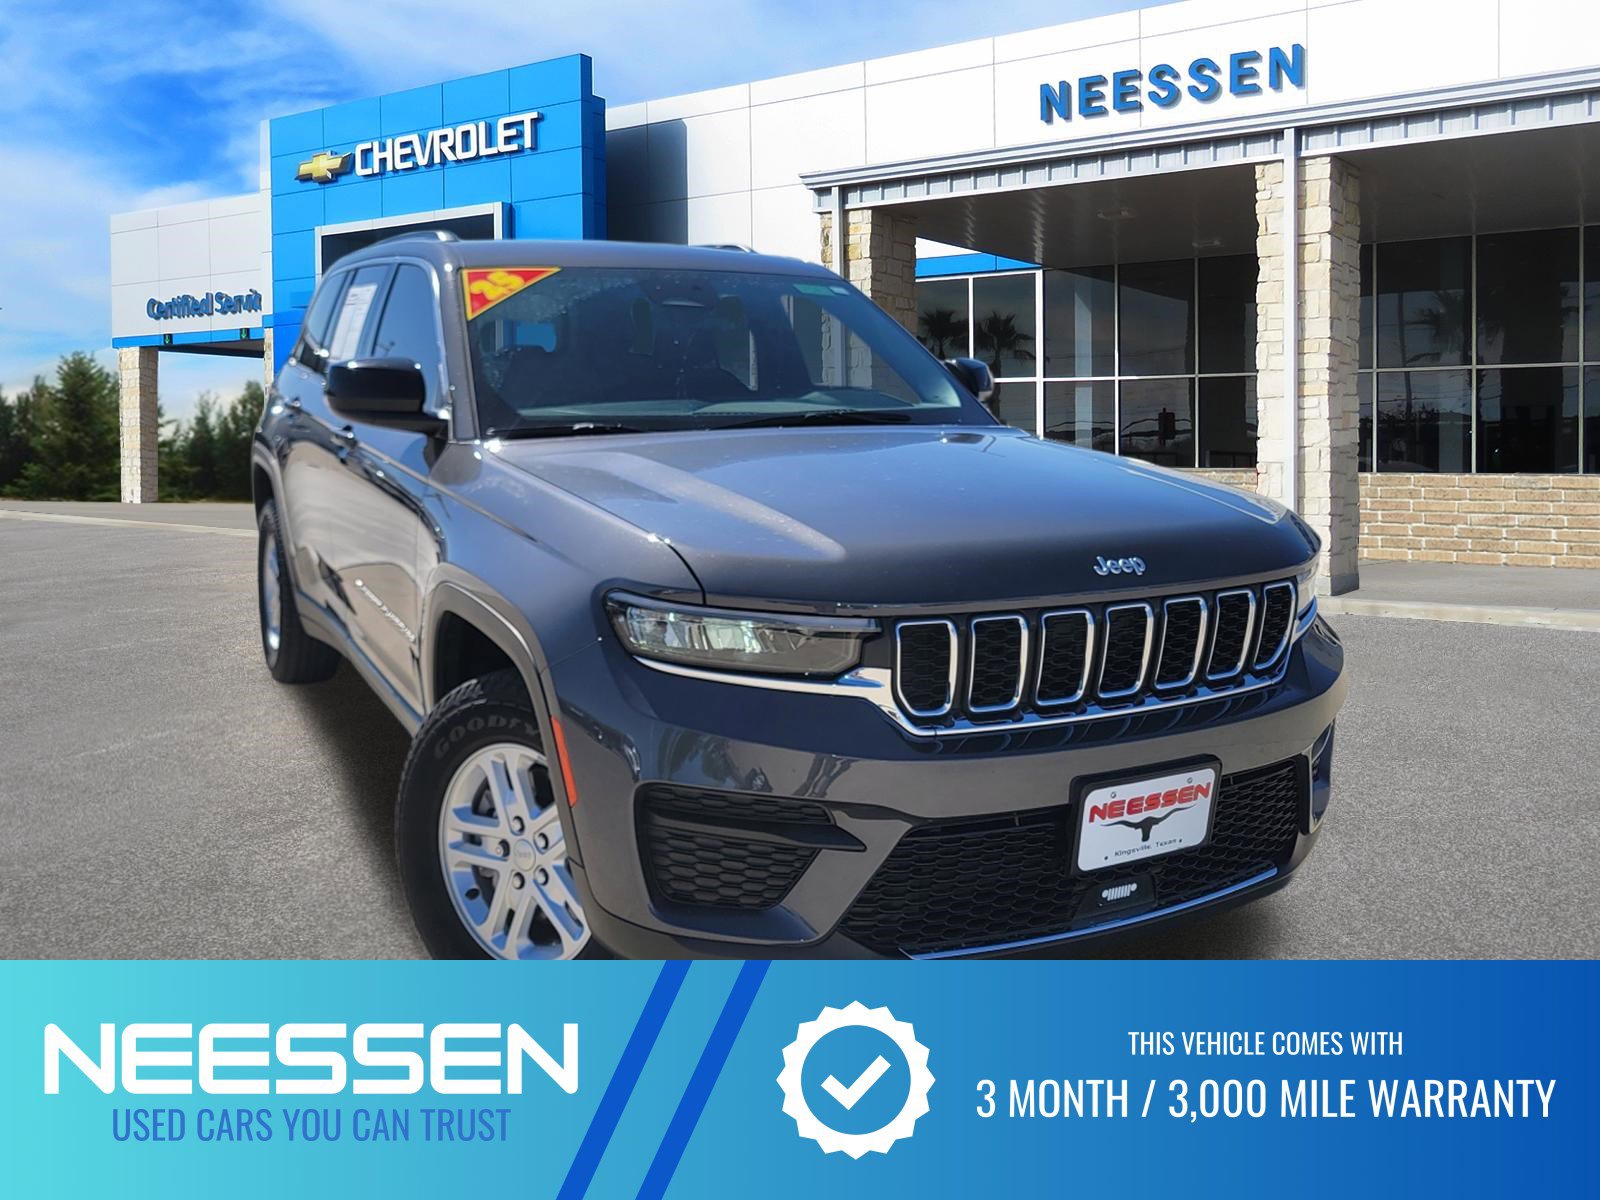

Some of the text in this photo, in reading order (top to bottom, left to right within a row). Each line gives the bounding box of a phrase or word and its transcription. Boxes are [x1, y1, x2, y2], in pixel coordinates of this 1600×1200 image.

[1040, 43, 1305, 125] NEESSEN
[355, 111, 543, 177] CHEVROLET
[146, 291, 214, 321] Certified
[1093, 555, 1146, 576] Jeep
[1089, 782, 1212, 823] NEESSEN
